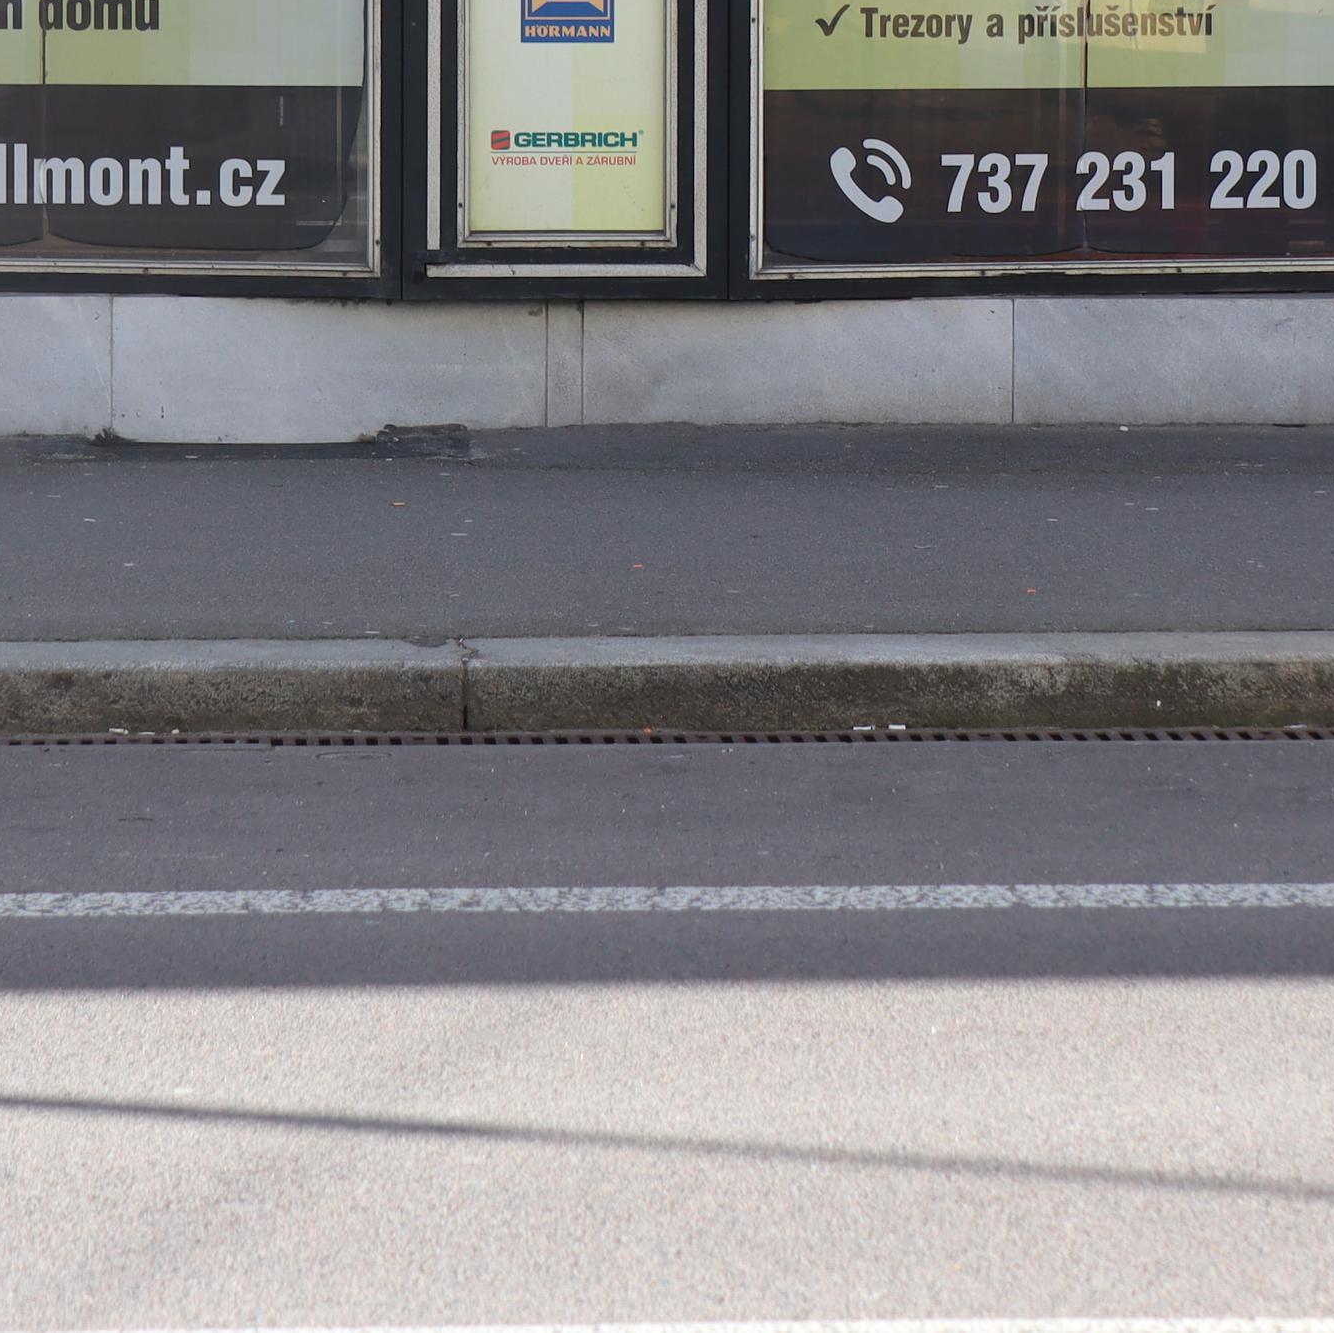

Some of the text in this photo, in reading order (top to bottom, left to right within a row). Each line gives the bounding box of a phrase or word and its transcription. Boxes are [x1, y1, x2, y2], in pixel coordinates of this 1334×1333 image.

[524, 23, 611, 38] HÖRMANN
[860, 4, 1217, 45] Trezory a příslušenství
[514, 132, 638, 148] GERBRICH
[491, 154, 636, 166] VÝROBA DVEŘÍ A ZÁRUBNÍ
[940, 149, 1317, 214] 737 231 220
